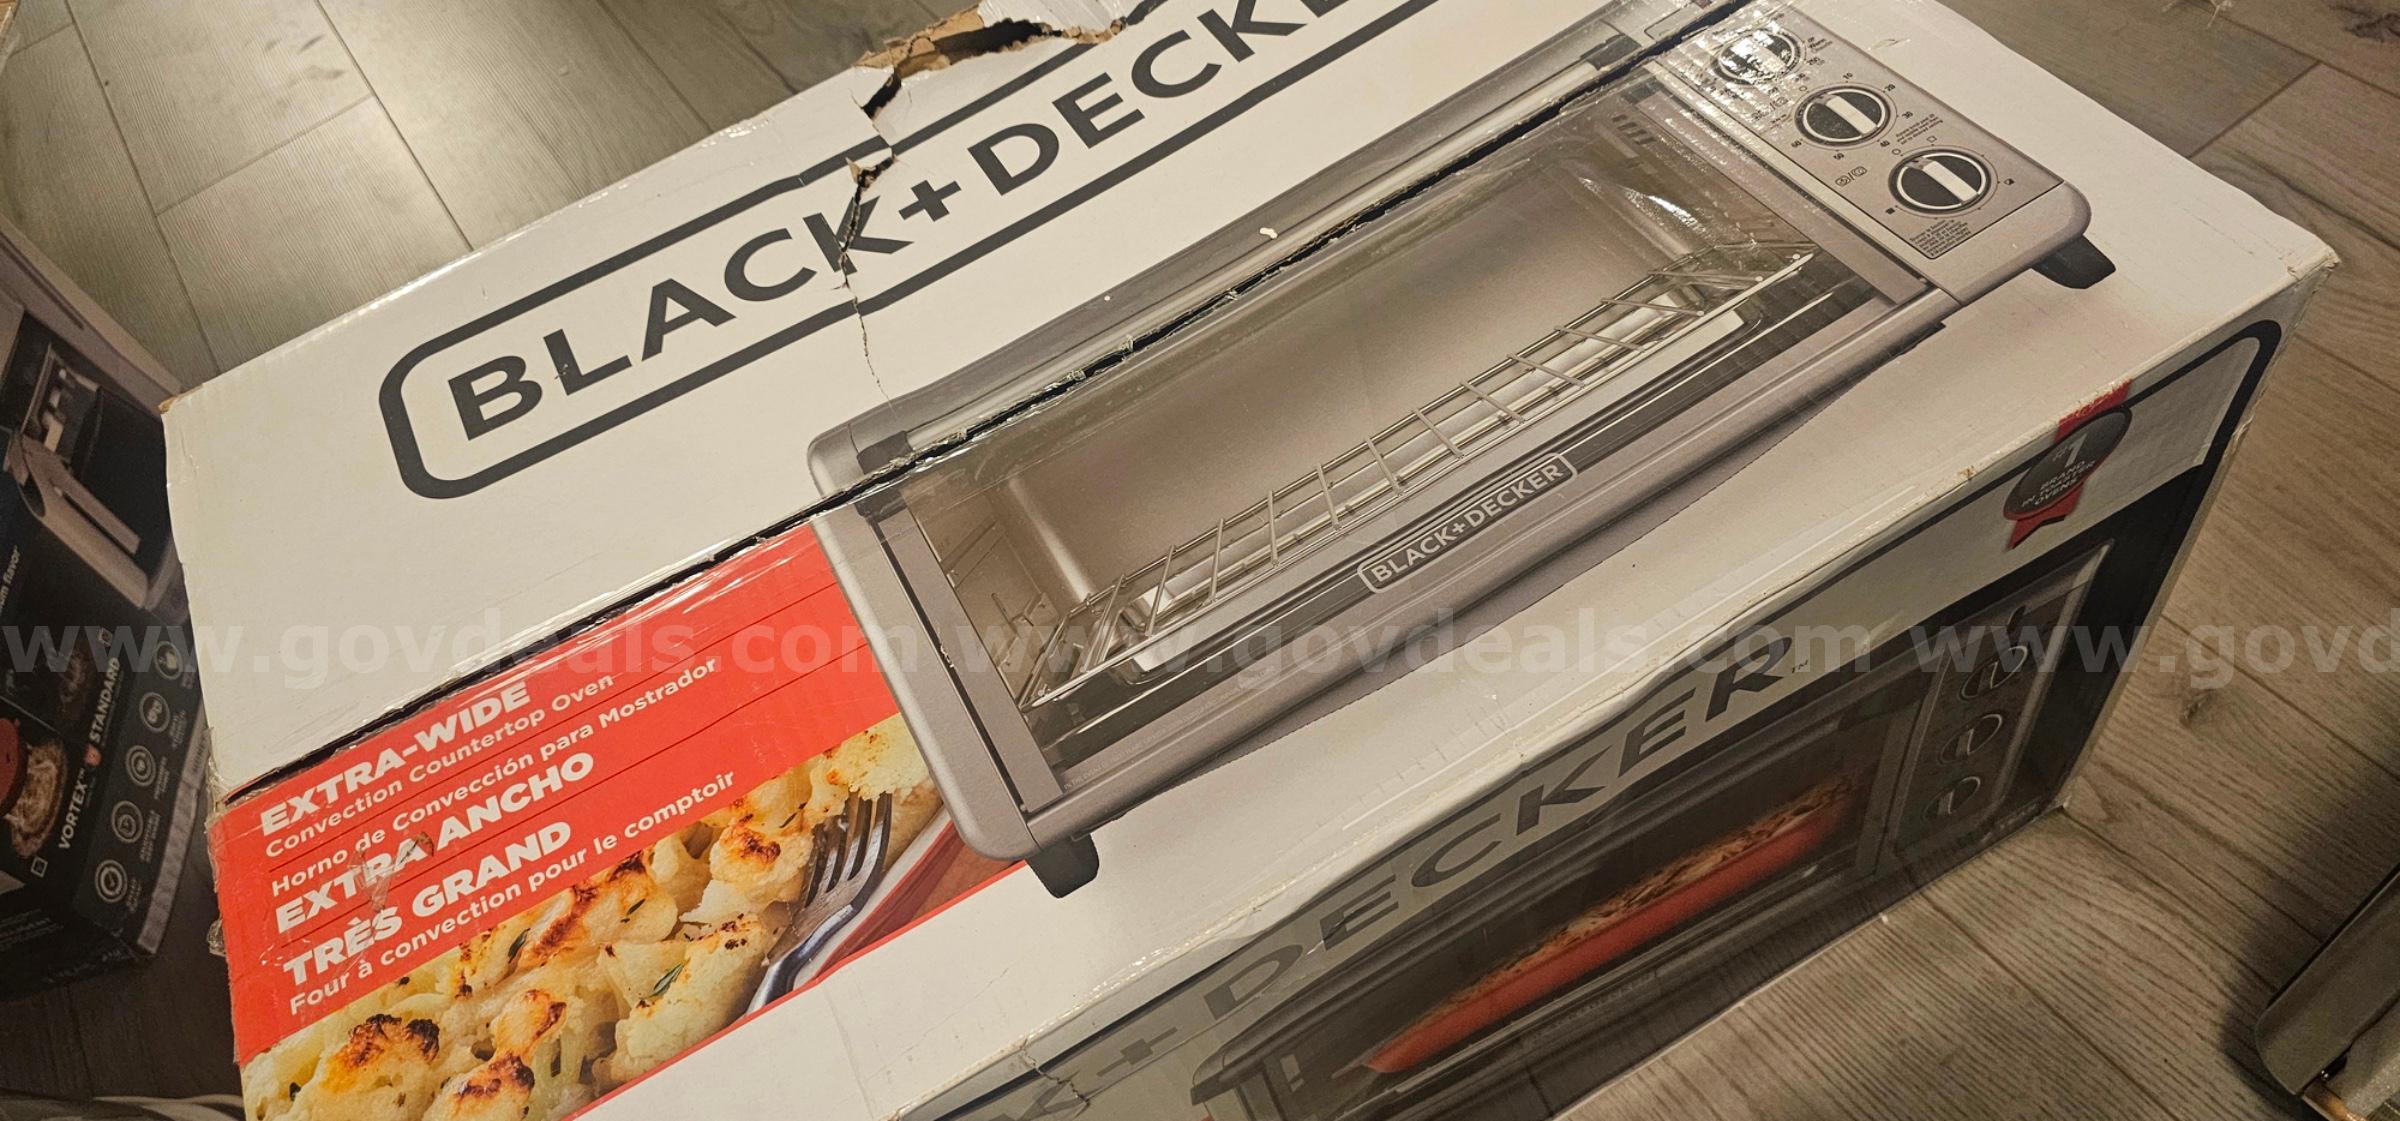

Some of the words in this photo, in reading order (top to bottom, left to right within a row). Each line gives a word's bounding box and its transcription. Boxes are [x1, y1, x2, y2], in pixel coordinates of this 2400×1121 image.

[1371, 463, 1565, 583] BLACK+DECKER
[89, 656, 121, 744] STANDARD
[260, 681, 530, 836] EXTRA-WIDE
[265, 778, 403, 858] Convection
[408, 705, 545, 783] Countertop
[551, 674, 615, 712] Oven
[271, 848, 348, 897] Horno
[355, 828, 386, 852] de
[392, 752, 534, 832] Convección
[540, 724, 594, 763] para
[598, 656, 718, 729] Mostrador
[275, 837, 430, 934] EXTRA
[436, 752, 594, 851] ANCHO
[283, 906, 402, 987] TRÈS
[411, 821, 571, 918] GRAND
[289, 969, 350, 1016] Four
[357, 958, 373, 980] à
[380, 884, 522, 966] convection
[528, 848, 587, 893] pour
[594, 834, 618, 855] le
[623, 769, 735, 840] comptoir
